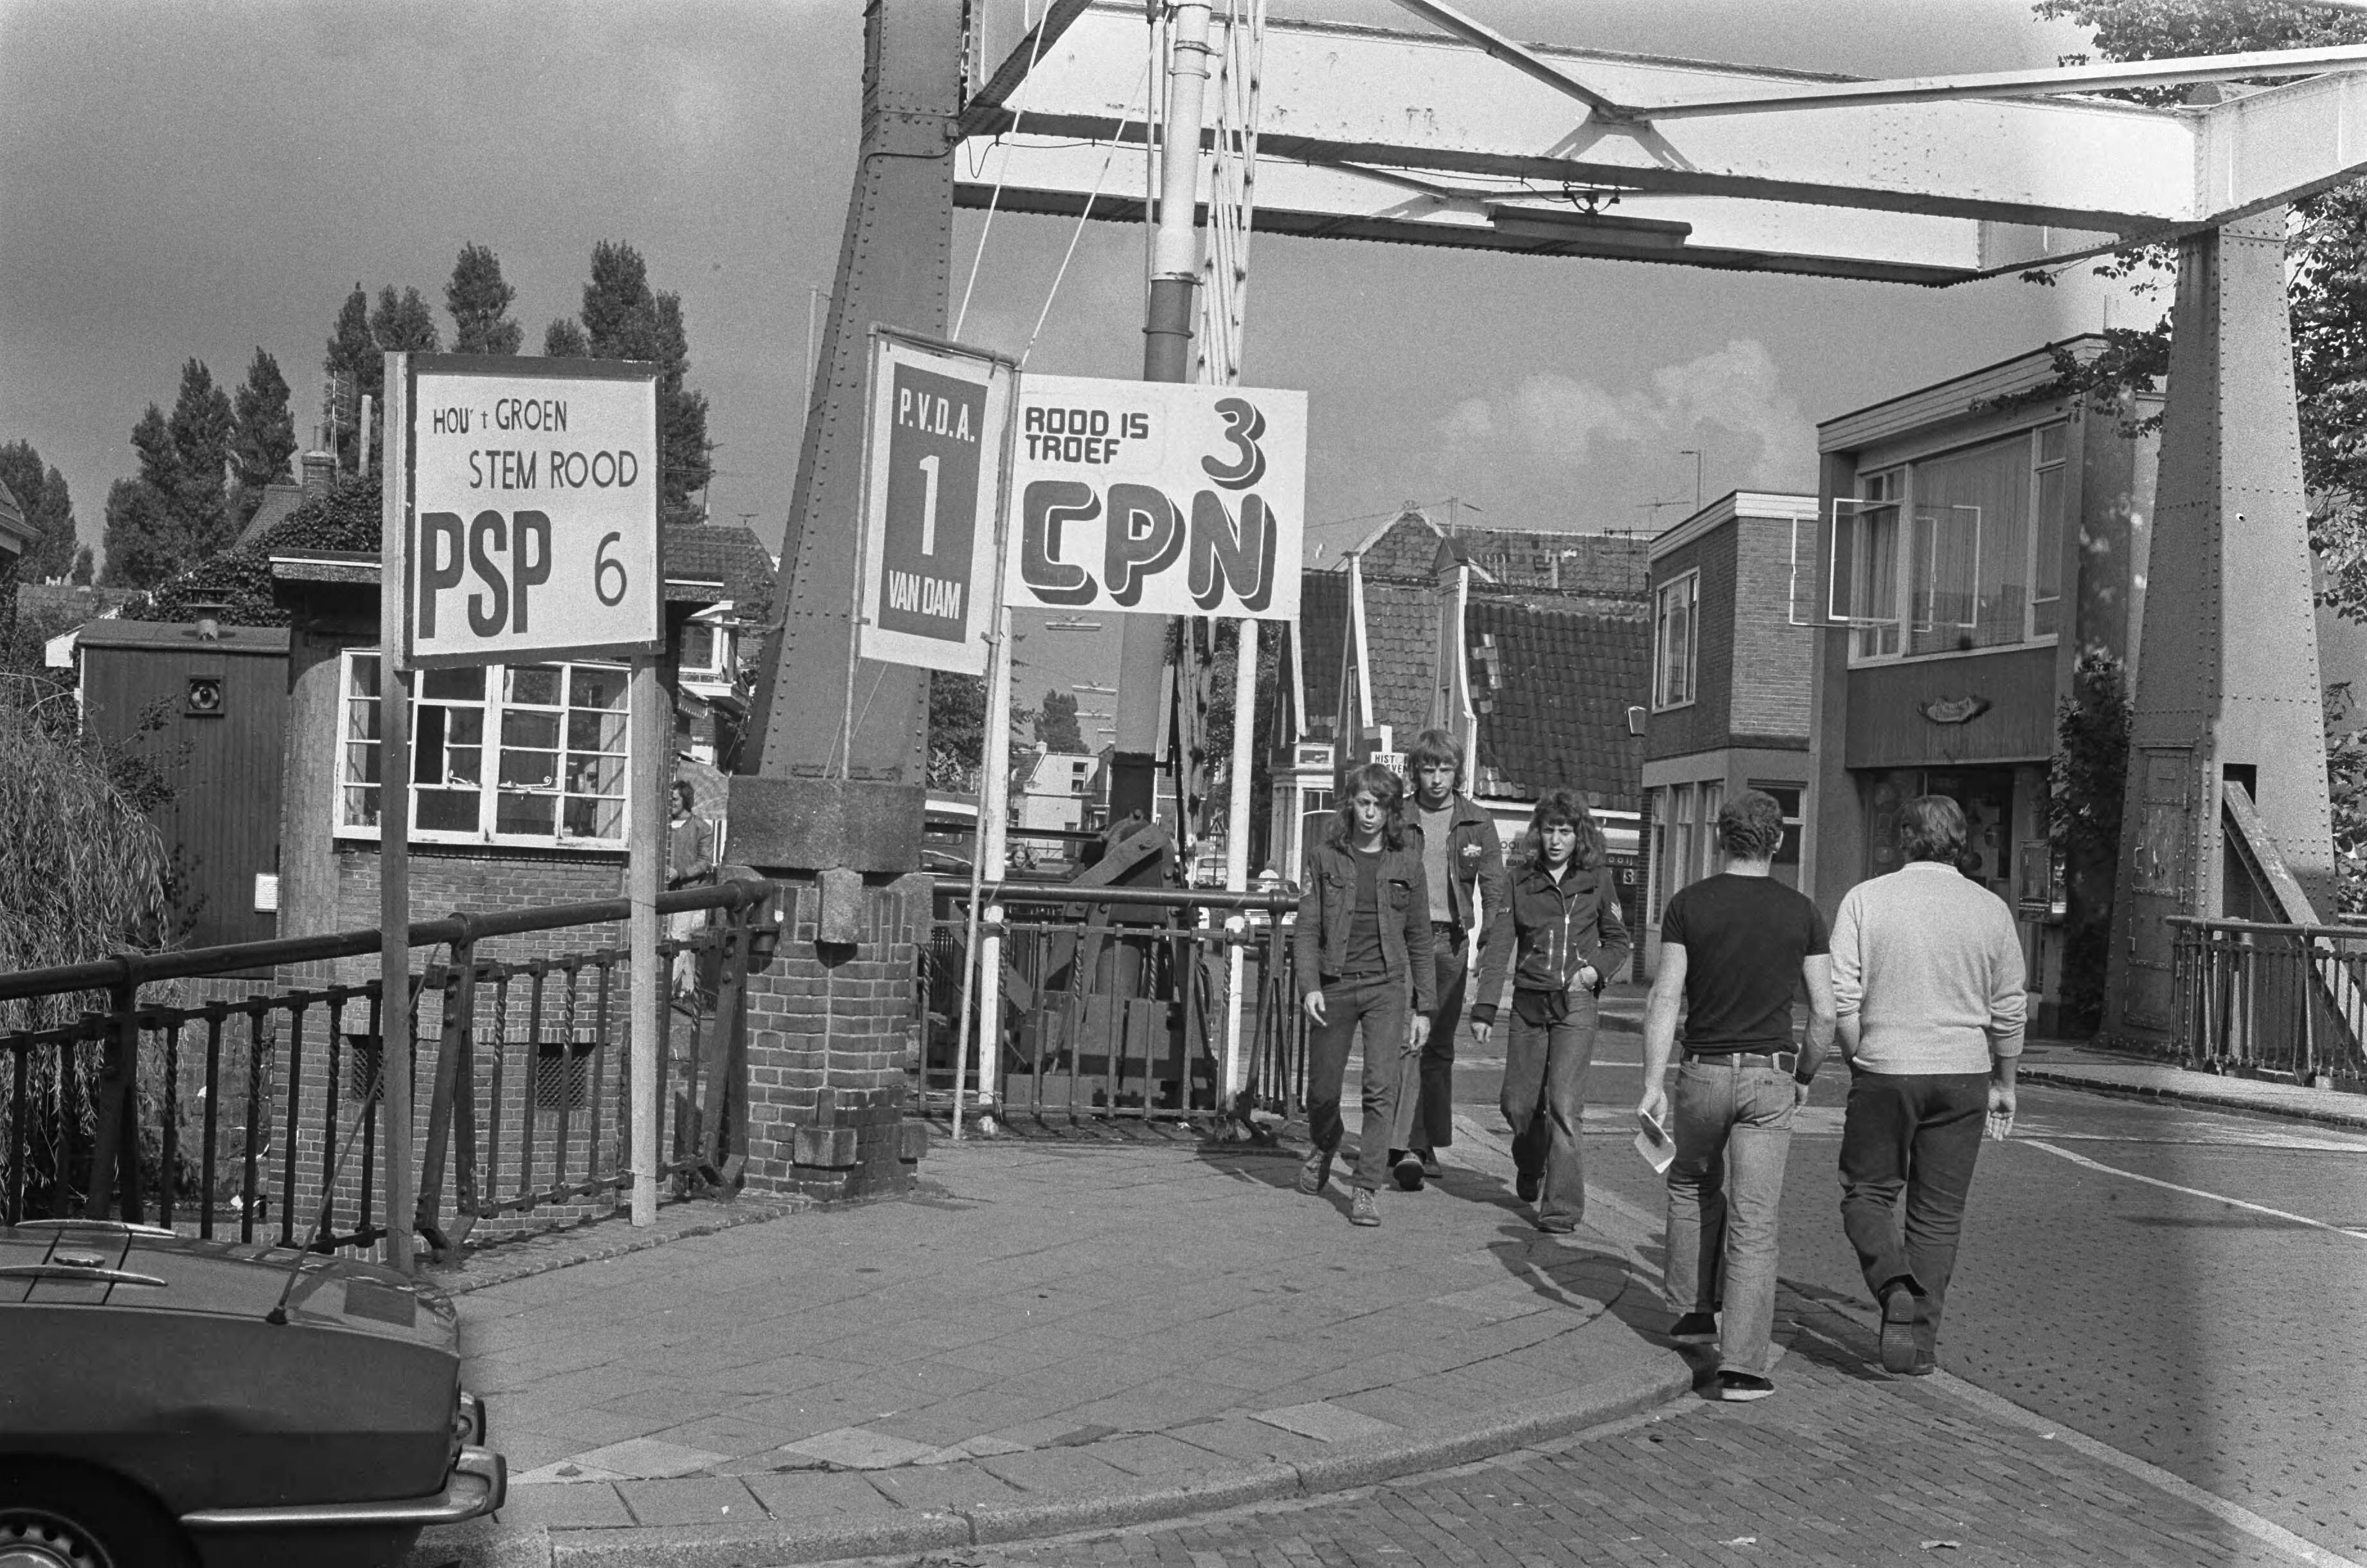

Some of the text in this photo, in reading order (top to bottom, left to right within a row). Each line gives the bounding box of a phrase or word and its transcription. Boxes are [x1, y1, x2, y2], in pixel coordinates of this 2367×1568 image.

[495, 398, 567, 431] GROEN
[899, 388, 976, 443] P.V.D.A.
[1025, 406, 1149, 440] ROOD IS
[469, 450, 638, 490] STEM ROOD
[1025, 435, 1121, 465] TROEF
[1201, 397, 1267, 490] 3
[919, 454, 940, 556] 1
[594, 531, 627, 607] 6
[1021, 479, 1278, 612] CPN
[418, 509, 552, 639] PSP
[889, 569, 962, 619] VAN DAM
